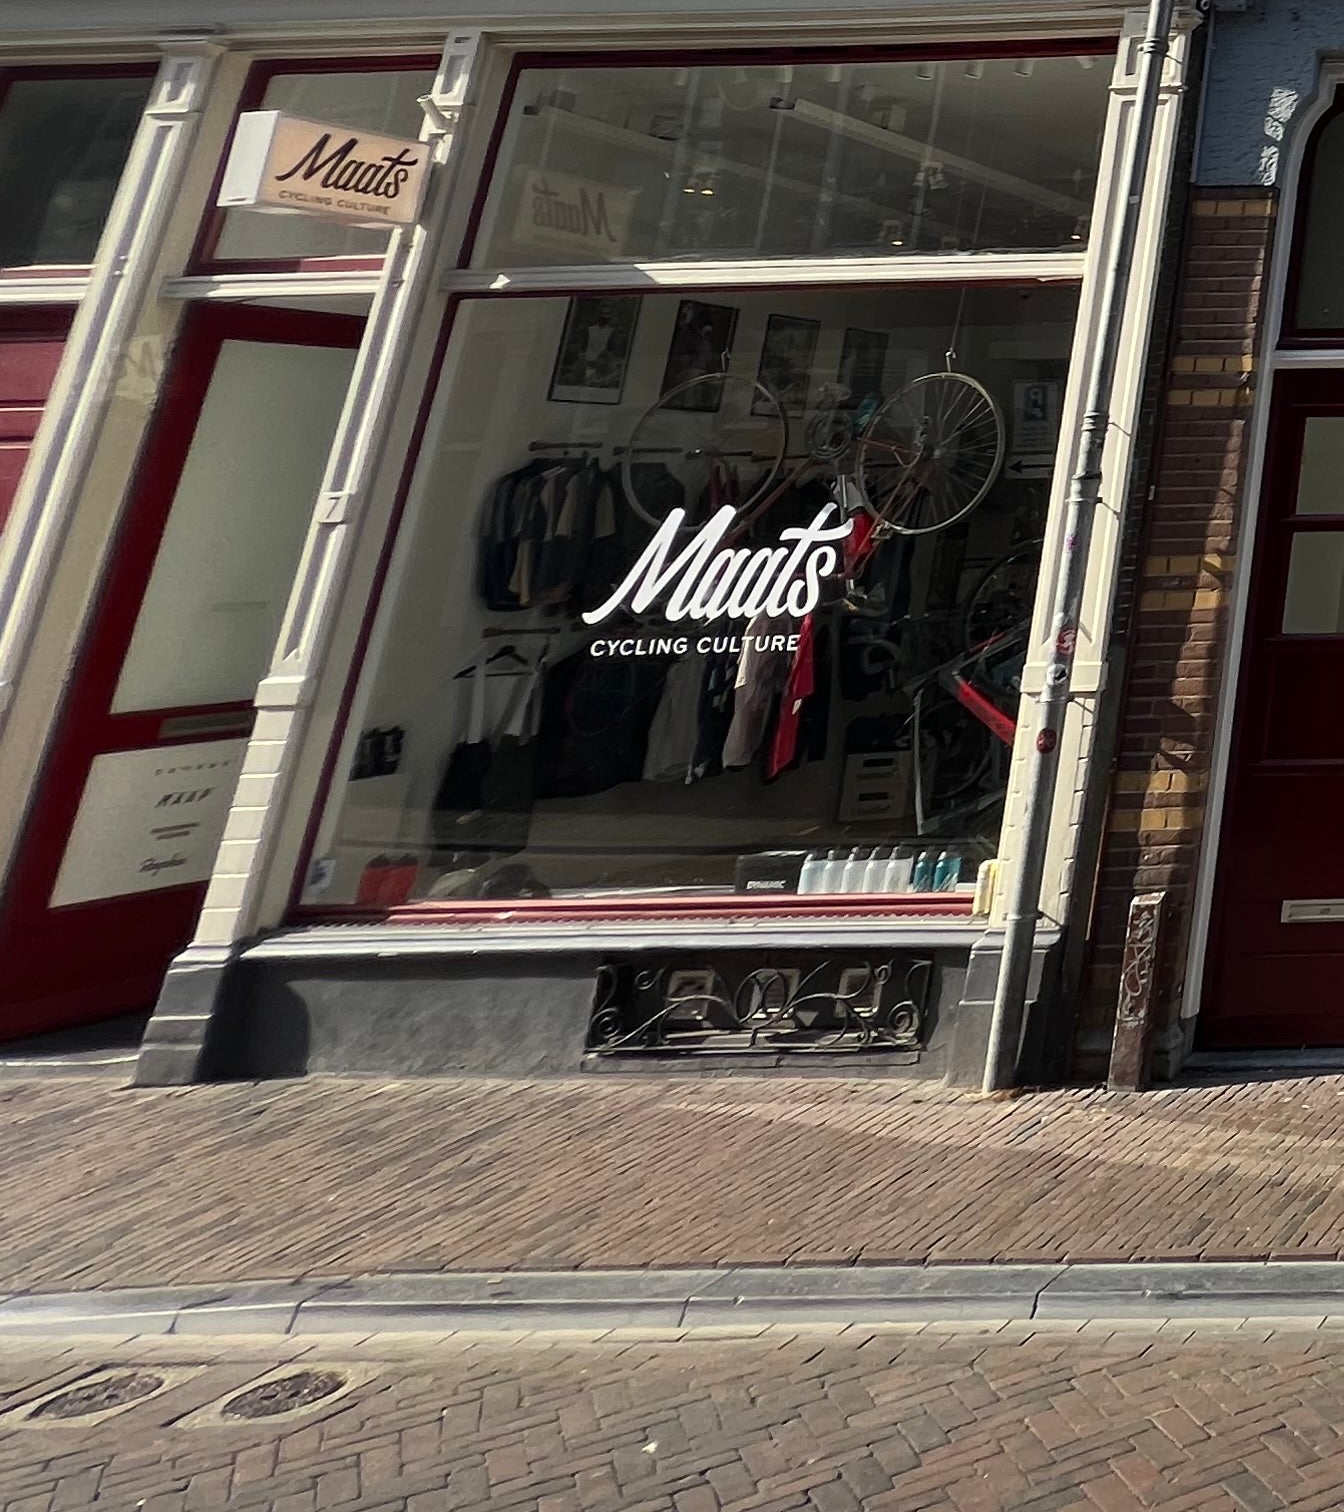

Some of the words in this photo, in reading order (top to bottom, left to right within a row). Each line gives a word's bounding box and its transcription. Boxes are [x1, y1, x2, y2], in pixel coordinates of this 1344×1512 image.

[274, 132, 419, 201] Maats
[278, 189, 333, 208] CYCLING
[336, 197, 391, 216] CULTURE
[582, 502, 855, 625] Maats
[589, 636, 688, 658] CYCLING
[696, 633, 801, 656] CULTURE
